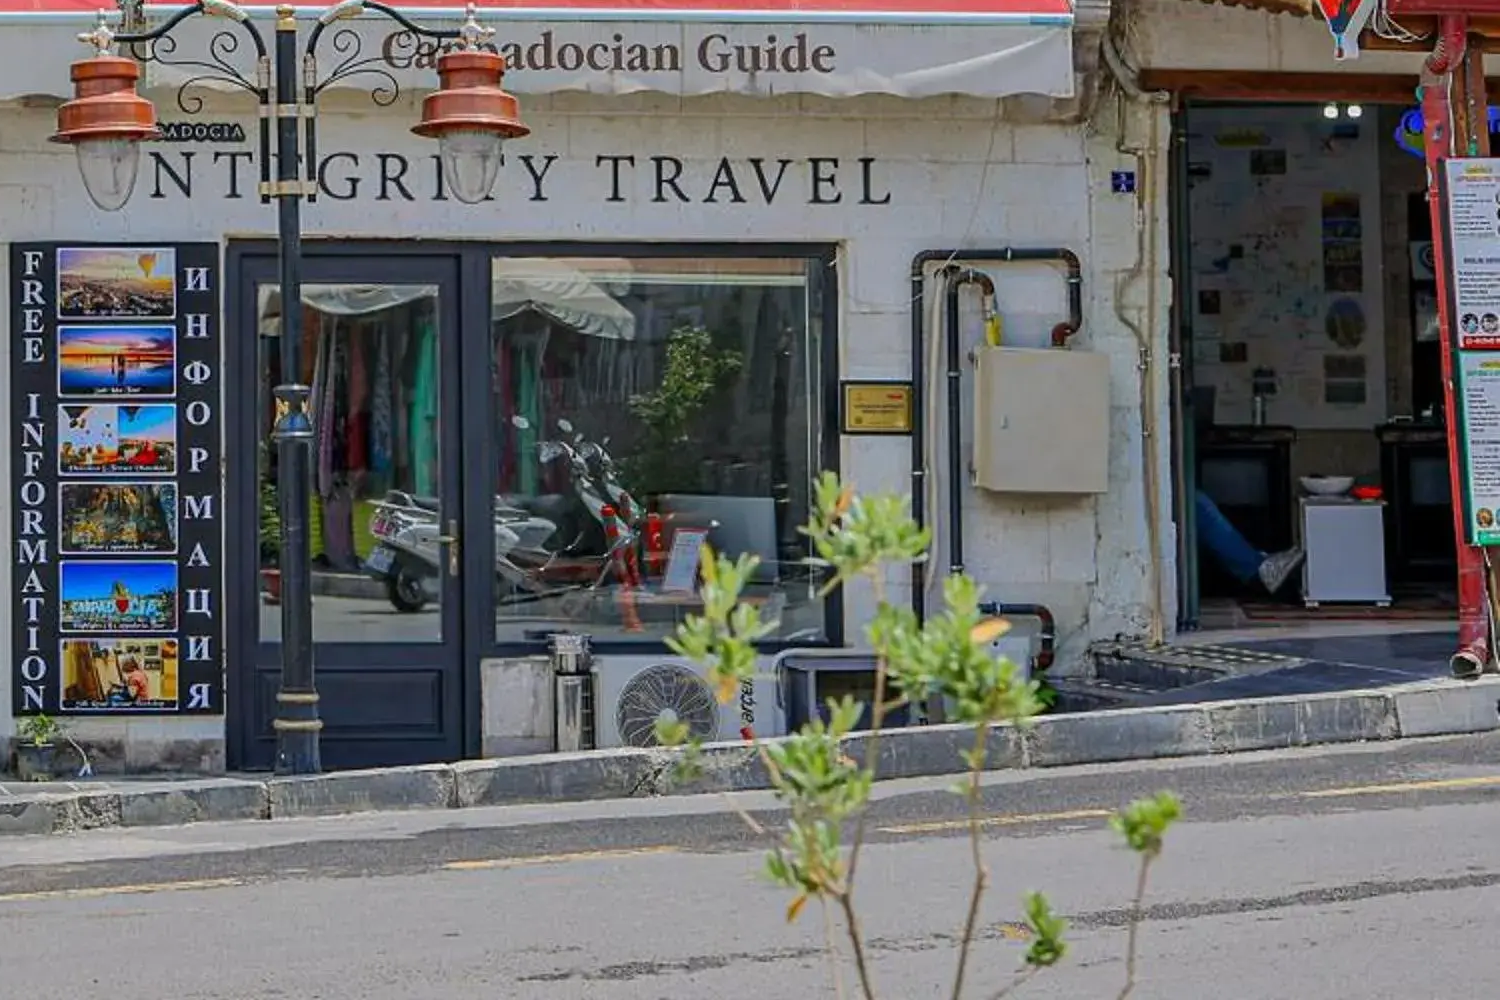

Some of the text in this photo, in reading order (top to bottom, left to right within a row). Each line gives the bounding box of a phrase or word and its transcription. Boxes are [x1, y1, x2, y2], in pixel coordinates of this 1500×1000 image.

[697, 33, 837, 74] Guide
[595, 155, 892, 204] TRAVEL
[17, 251, 50, 711] FREE INFORMATION
[183, 266, 214, 709] ИНФОРМАЦИЯ
